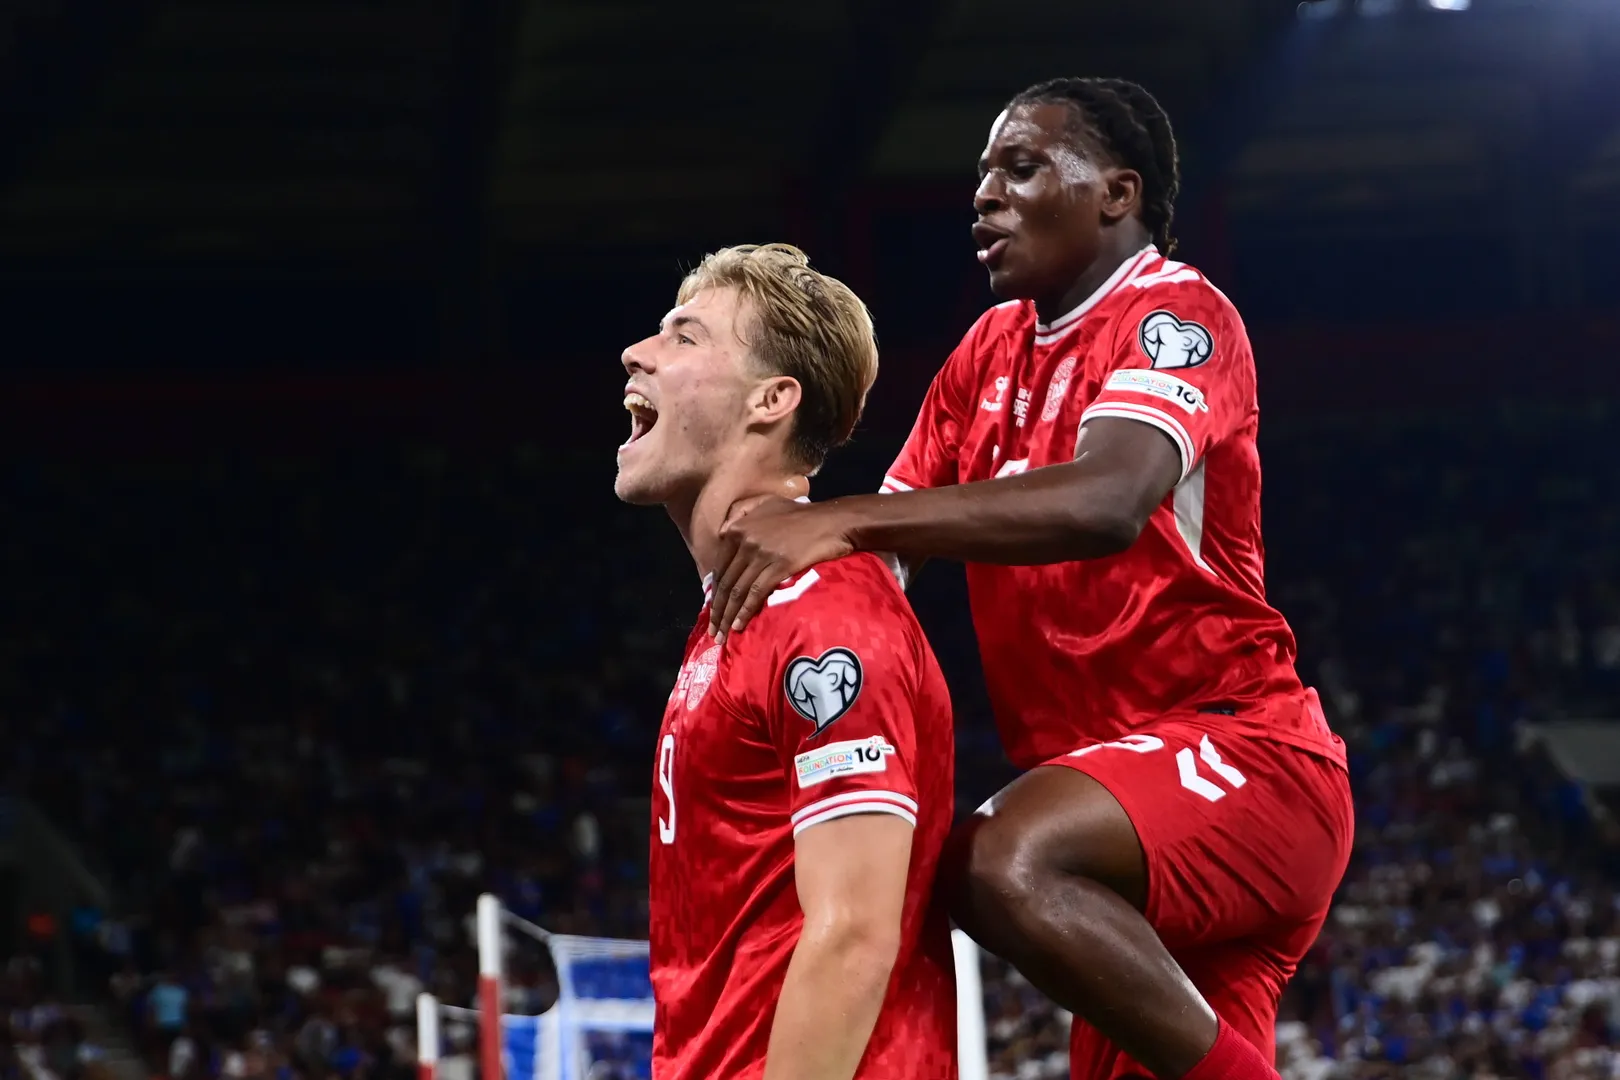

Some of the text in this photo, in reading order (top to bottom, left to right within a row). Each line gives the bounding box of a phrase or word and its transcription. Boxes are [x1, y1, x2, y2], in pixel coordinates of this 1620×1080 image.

[1176, 385, 1196, 404] 10
[798, 753, 853, 775] FOUNDATION
[854, 747, 880, 763] 10
[659, 734, 675, 844] 9
